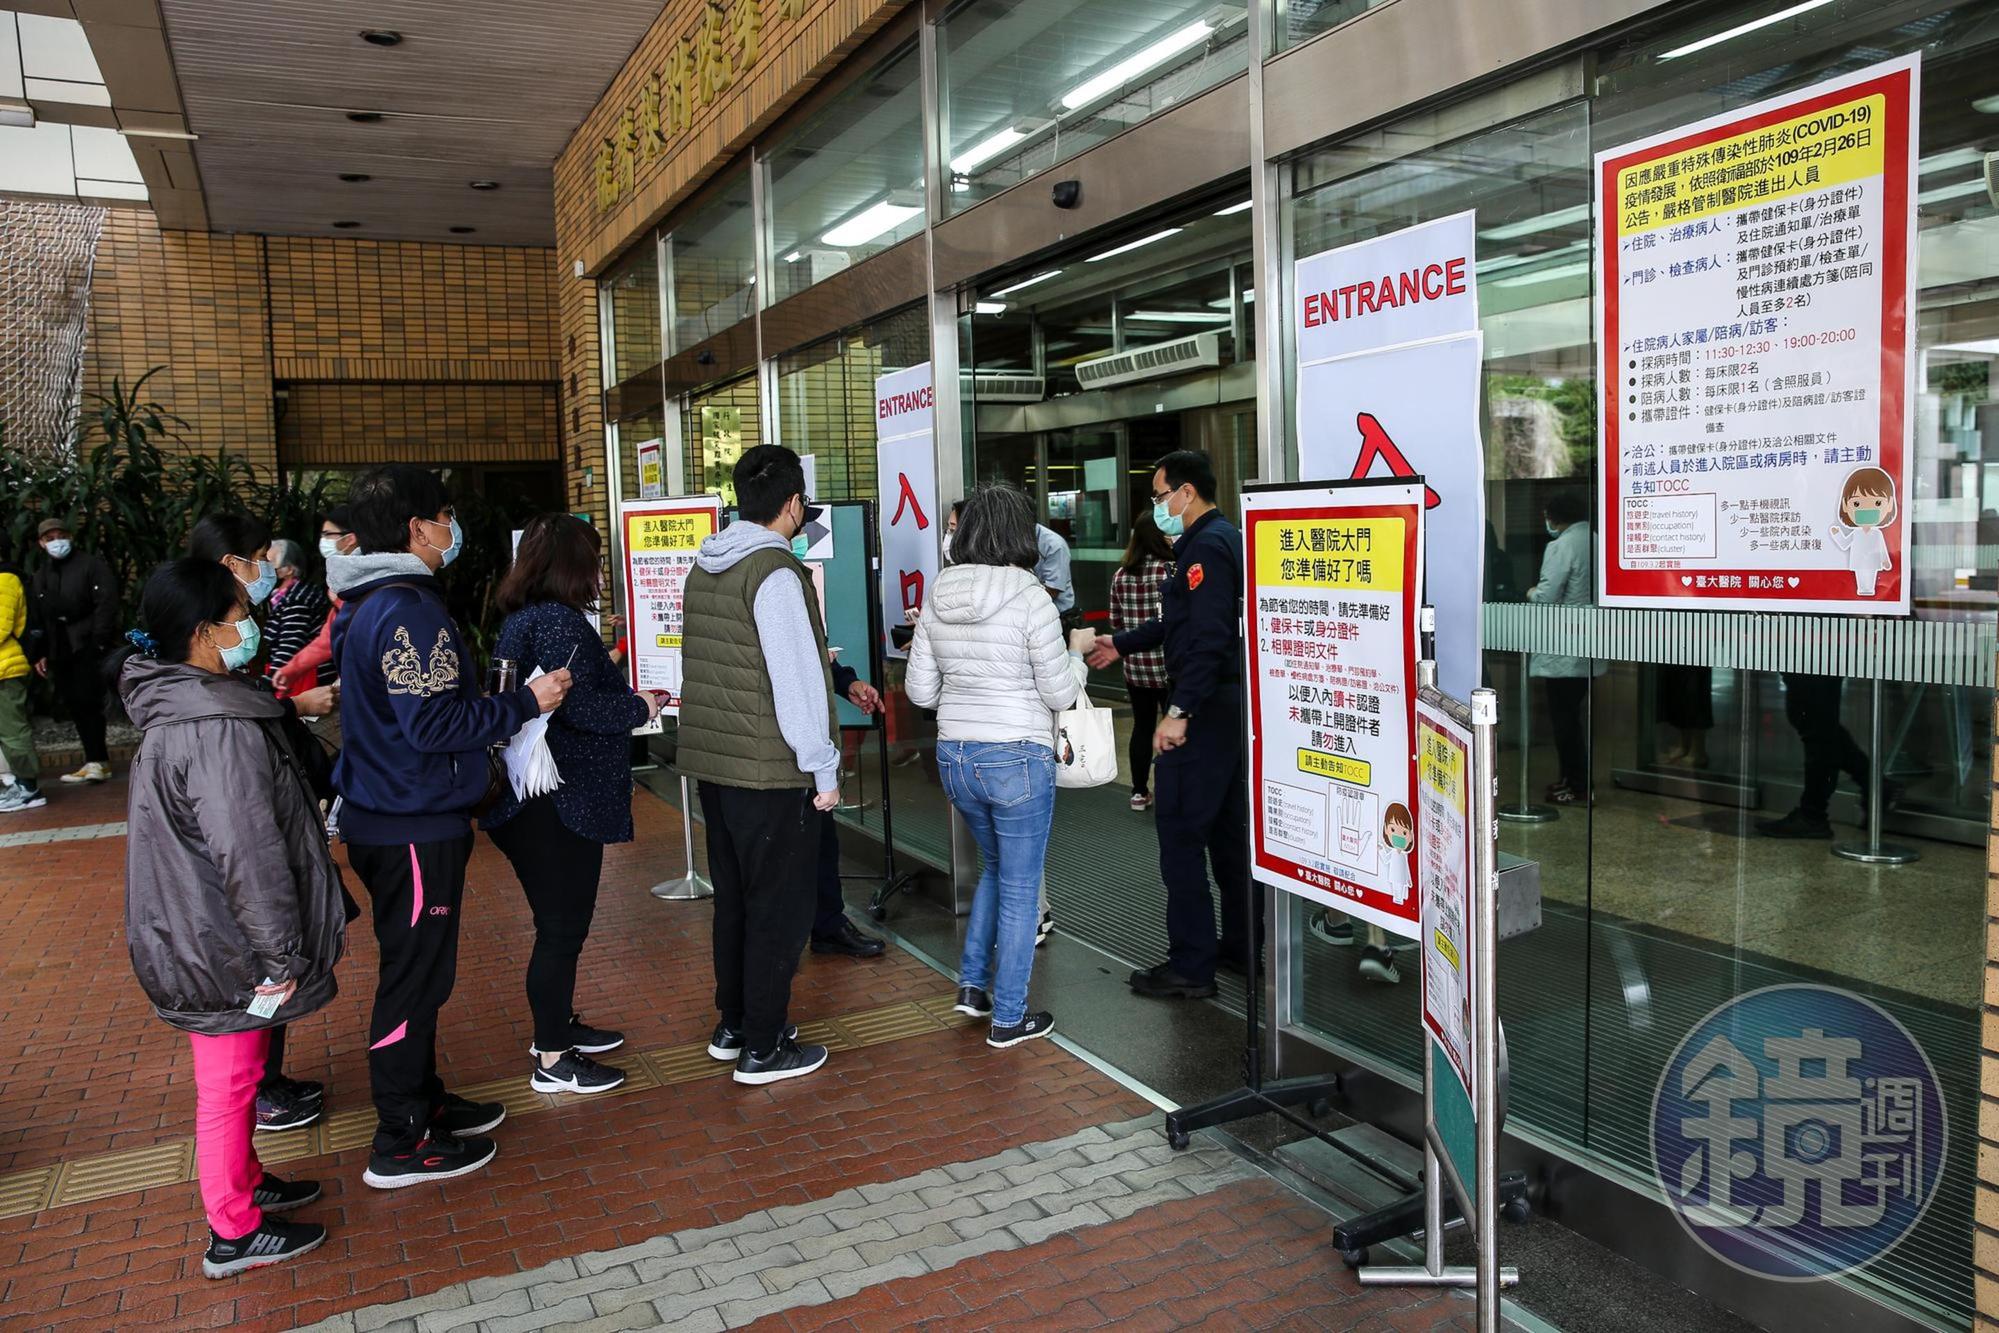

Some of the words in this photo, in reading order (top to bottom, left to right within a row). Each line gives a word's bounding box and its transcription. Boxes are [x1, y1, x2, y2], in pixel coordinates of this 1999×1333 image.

[1625, 105, 1871, 189] 因應嚴重特殊傳染性肺炎(COVID-19)
[1625, 165, 1820, 229] 公告，嚴格管制醫院進出人員
[1737, 205, 1861, 244] 及住院通知單/治療單
[1304, 257, 1466, 328] ENTRANCE
[1705, 361, 1759, 380] 每床限2名
[879, 386, 933, 419] ENTRANCE
[1632, 479, 1689, 495] 告知TOCC
[891, 472, 930, 612] 入口
[1280, 528, 1371, 553] 進入醫院大門
[1281, 558, 1371, 583] 您準備好了嗎
[1695, 575, 1742, 589] 臺大醫院
[1748, 575, 1784, 589] 關心您
[1271, 618, 1360, 641] 健保卡或身分證件
[1288, 684, 1381, 714] 以便入內讀卡認證
[1288, 706, 1381, 737] 未攜帶上開證件者
[1311, 730, 1357, 755] 請勿進入
[1305, 754, 1365, 779] 請主動告知TOCC
